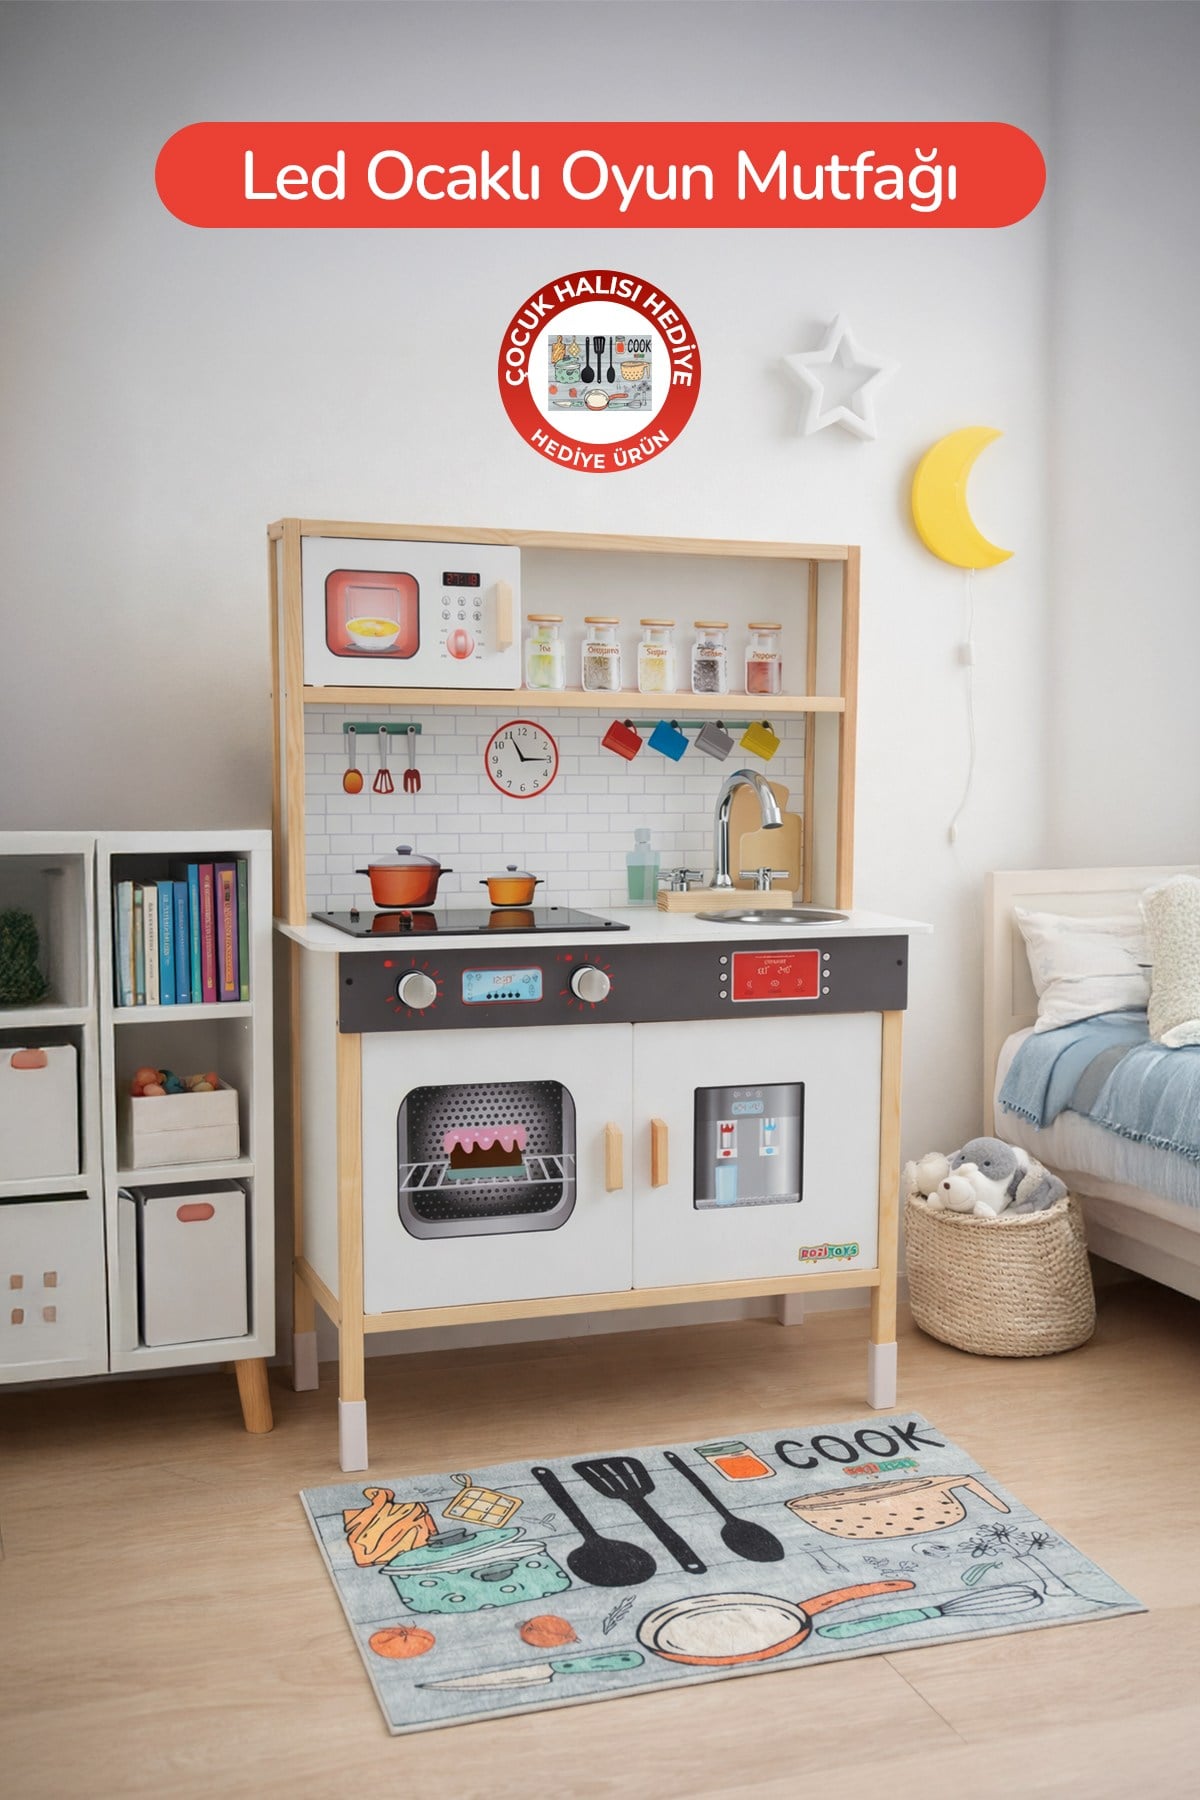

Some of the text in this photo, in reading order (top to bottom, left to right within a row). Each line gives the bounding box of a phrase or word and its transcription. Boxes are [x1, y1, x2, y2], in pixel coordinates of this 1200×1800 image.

[504, 731, 513, 740] 11
[517, 727, 528, 737] 12
[494, 740, 505, 750] 10
[542, 741, 549, 751] 2
[492, 755, 499, 764] 9
[546, 754, 552, 764] 3
[496, 769, 503, 778] 8
[542, 769, 548, 777] 4
[506, 780, 512, 788] 7
[519, 783, 526, 792] 6
[533, 779, 539, 788] 5
[774, 1421, 945, 1469] COOK
